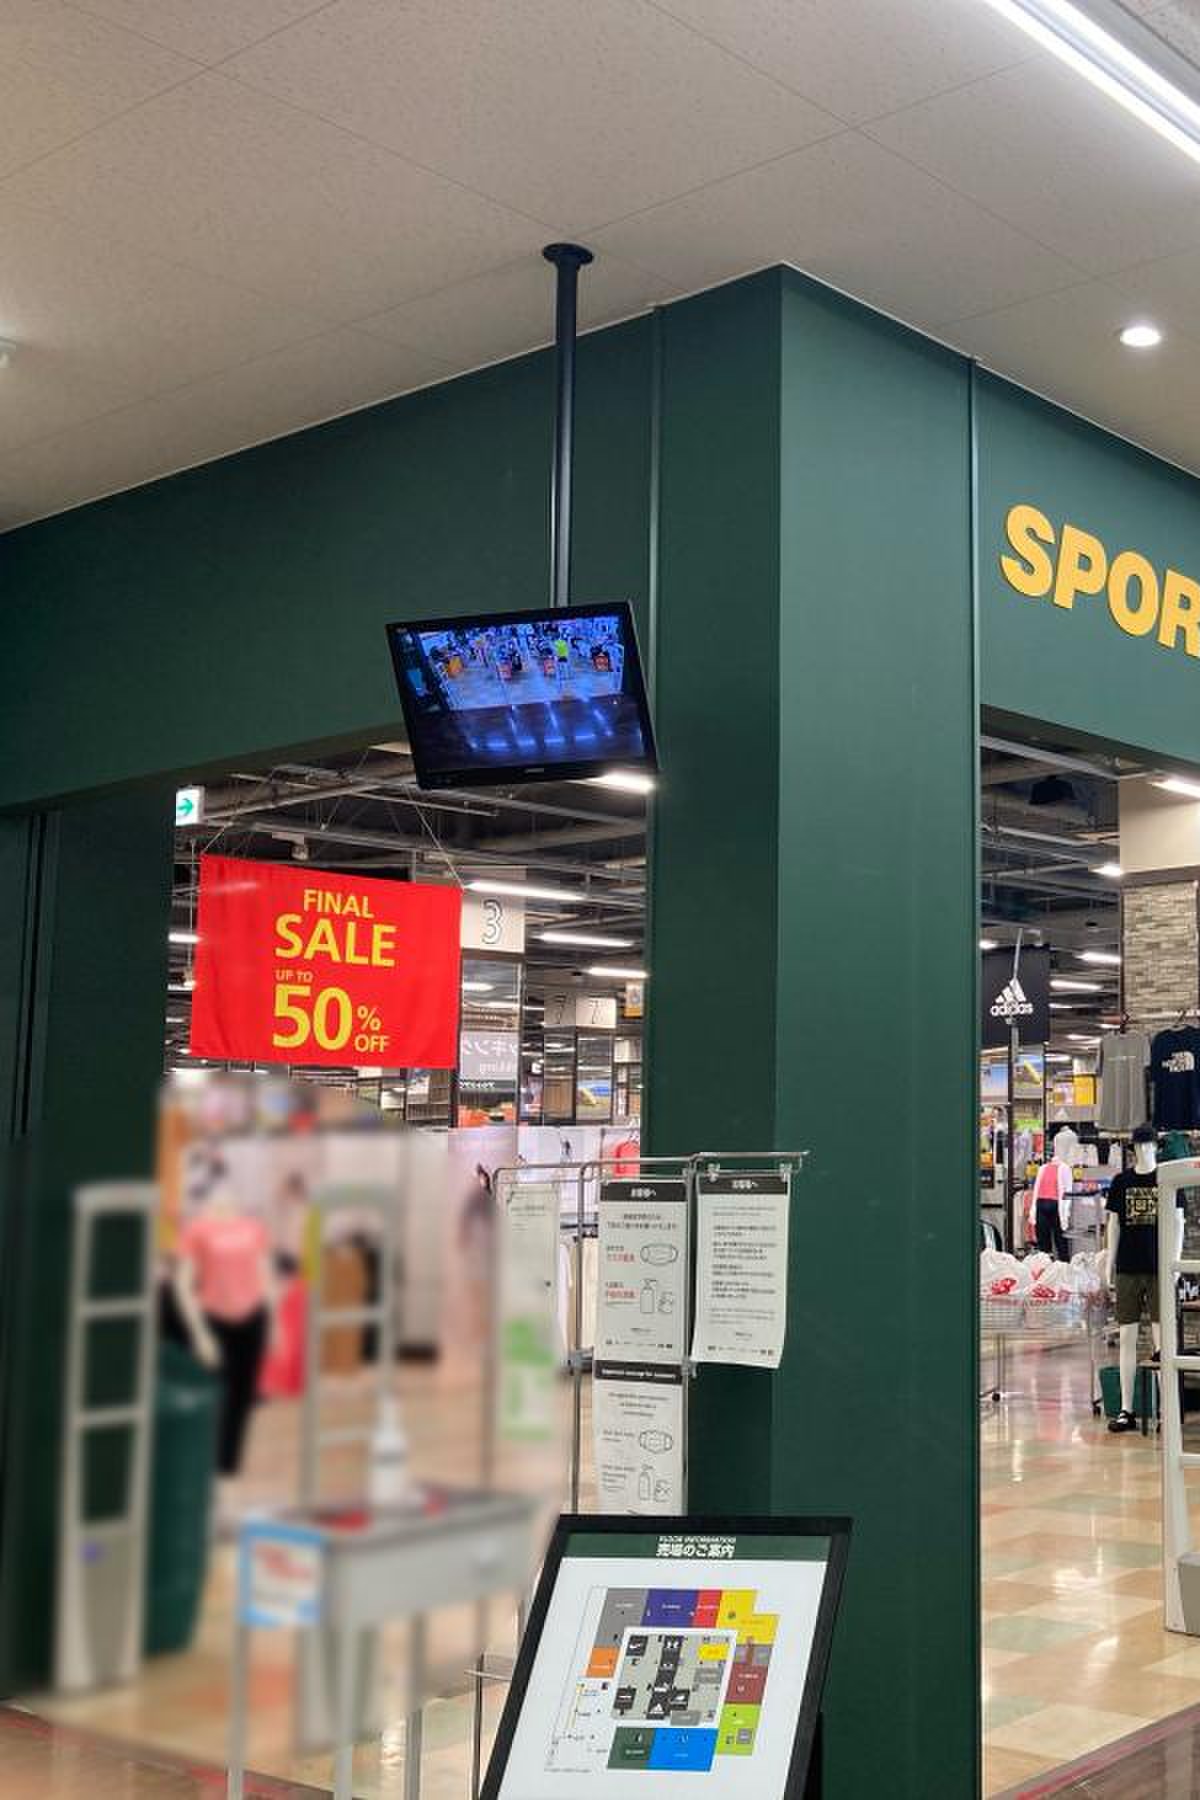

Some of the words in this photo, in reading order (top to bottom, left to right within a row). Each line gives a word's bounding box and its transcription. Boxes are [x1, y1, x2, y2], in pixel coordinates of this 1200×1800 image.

[303, 889, 375, 919] FINAL
[482, 899, 503, 945] 3
[274, 913, 398, 968] SALE
[275, 969, 294, 982] UP
[296, 971, 314, 984] TO
[989, 1002, 1034, 1017] adidas
[354, 1034, 391, 1053] OFF
